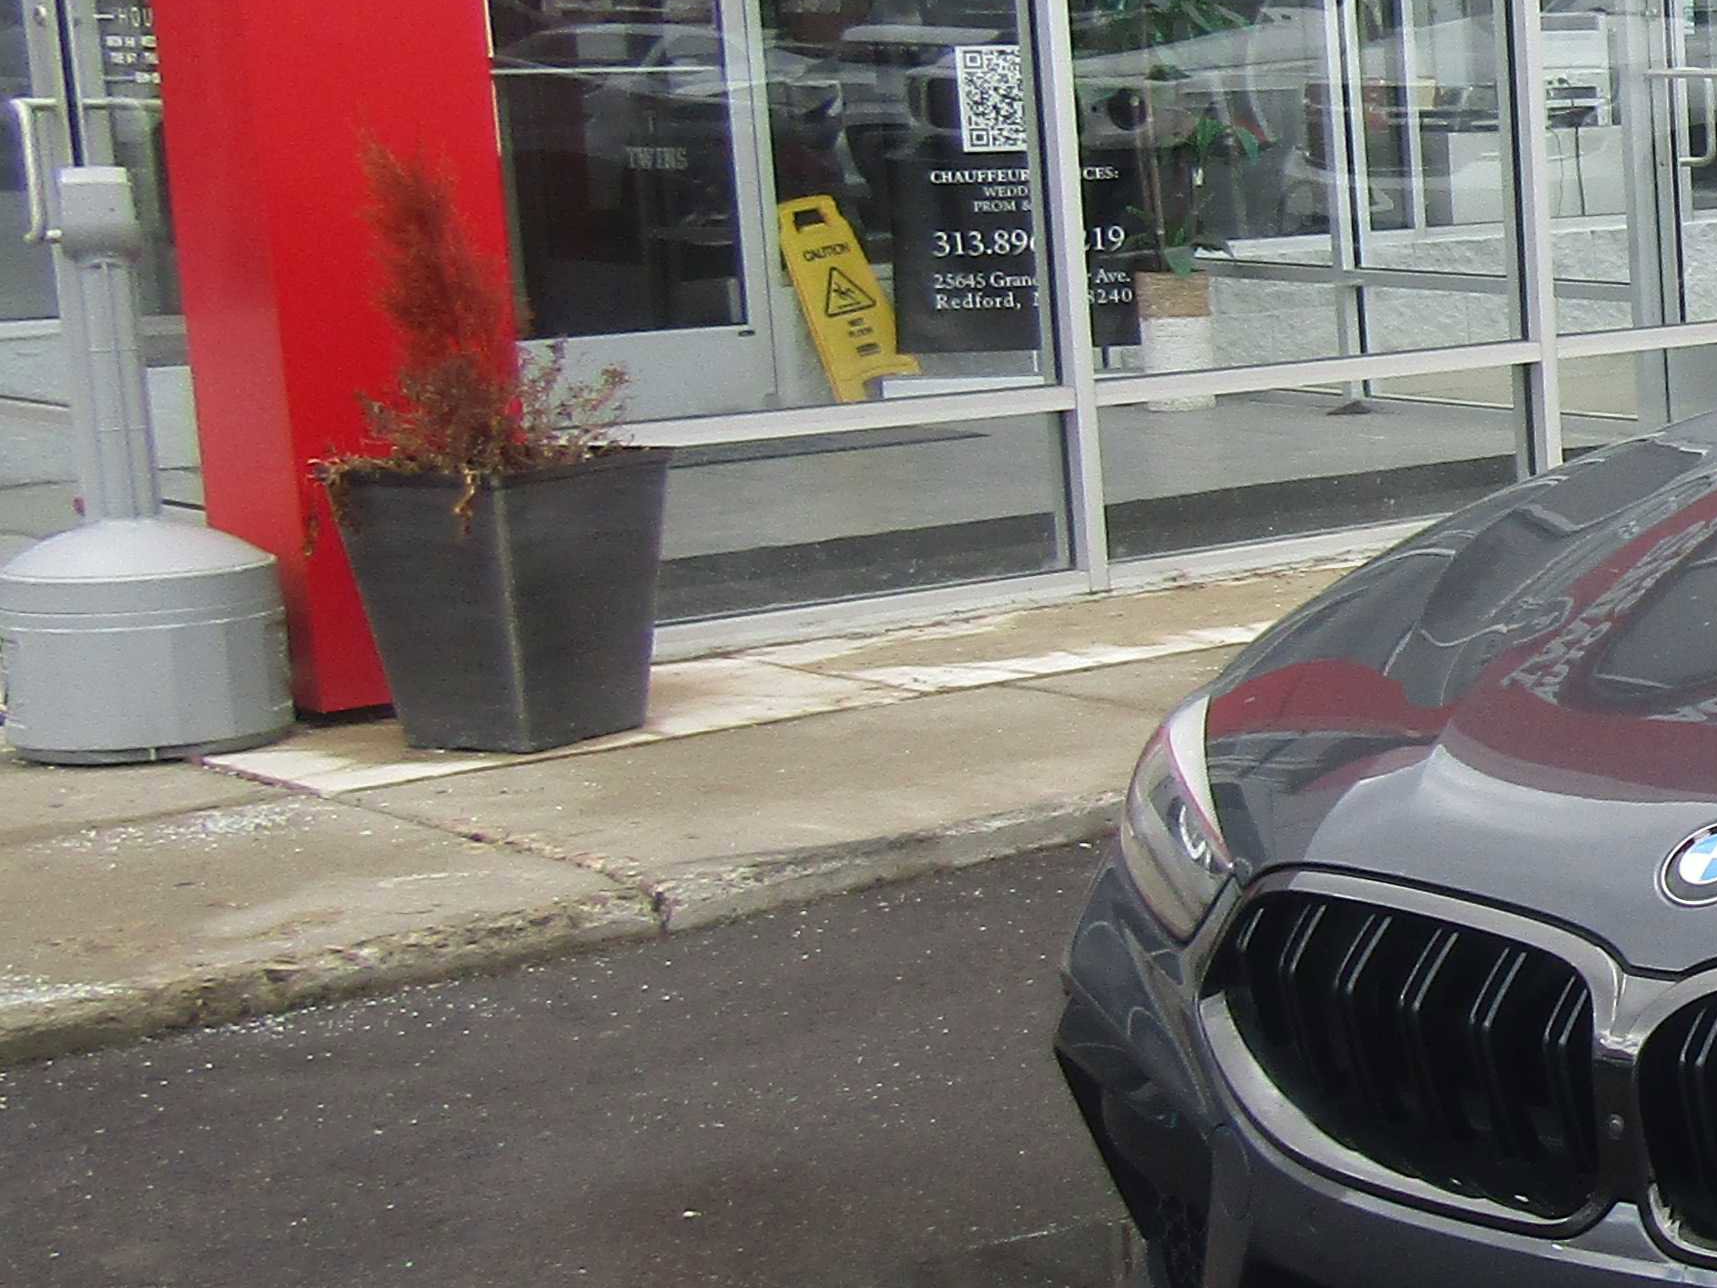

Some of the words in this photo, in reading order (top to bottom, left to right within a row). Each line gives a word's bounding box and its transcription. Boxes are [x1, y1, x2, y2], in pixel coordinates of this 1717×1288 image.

[117, 7, 153, 27] HOU
[984, 186, 1029, 197] WEDD
[974, 200, 1016, 212] PROM
[932, 225, 1125, 257] 313.8919
[802, 242, 851, 262] CAUTION
[933, 273, 986, 289] 25645
[1095, 269, 1131, 284] Ave.
[936, 292, 1021, 309] Redford,
